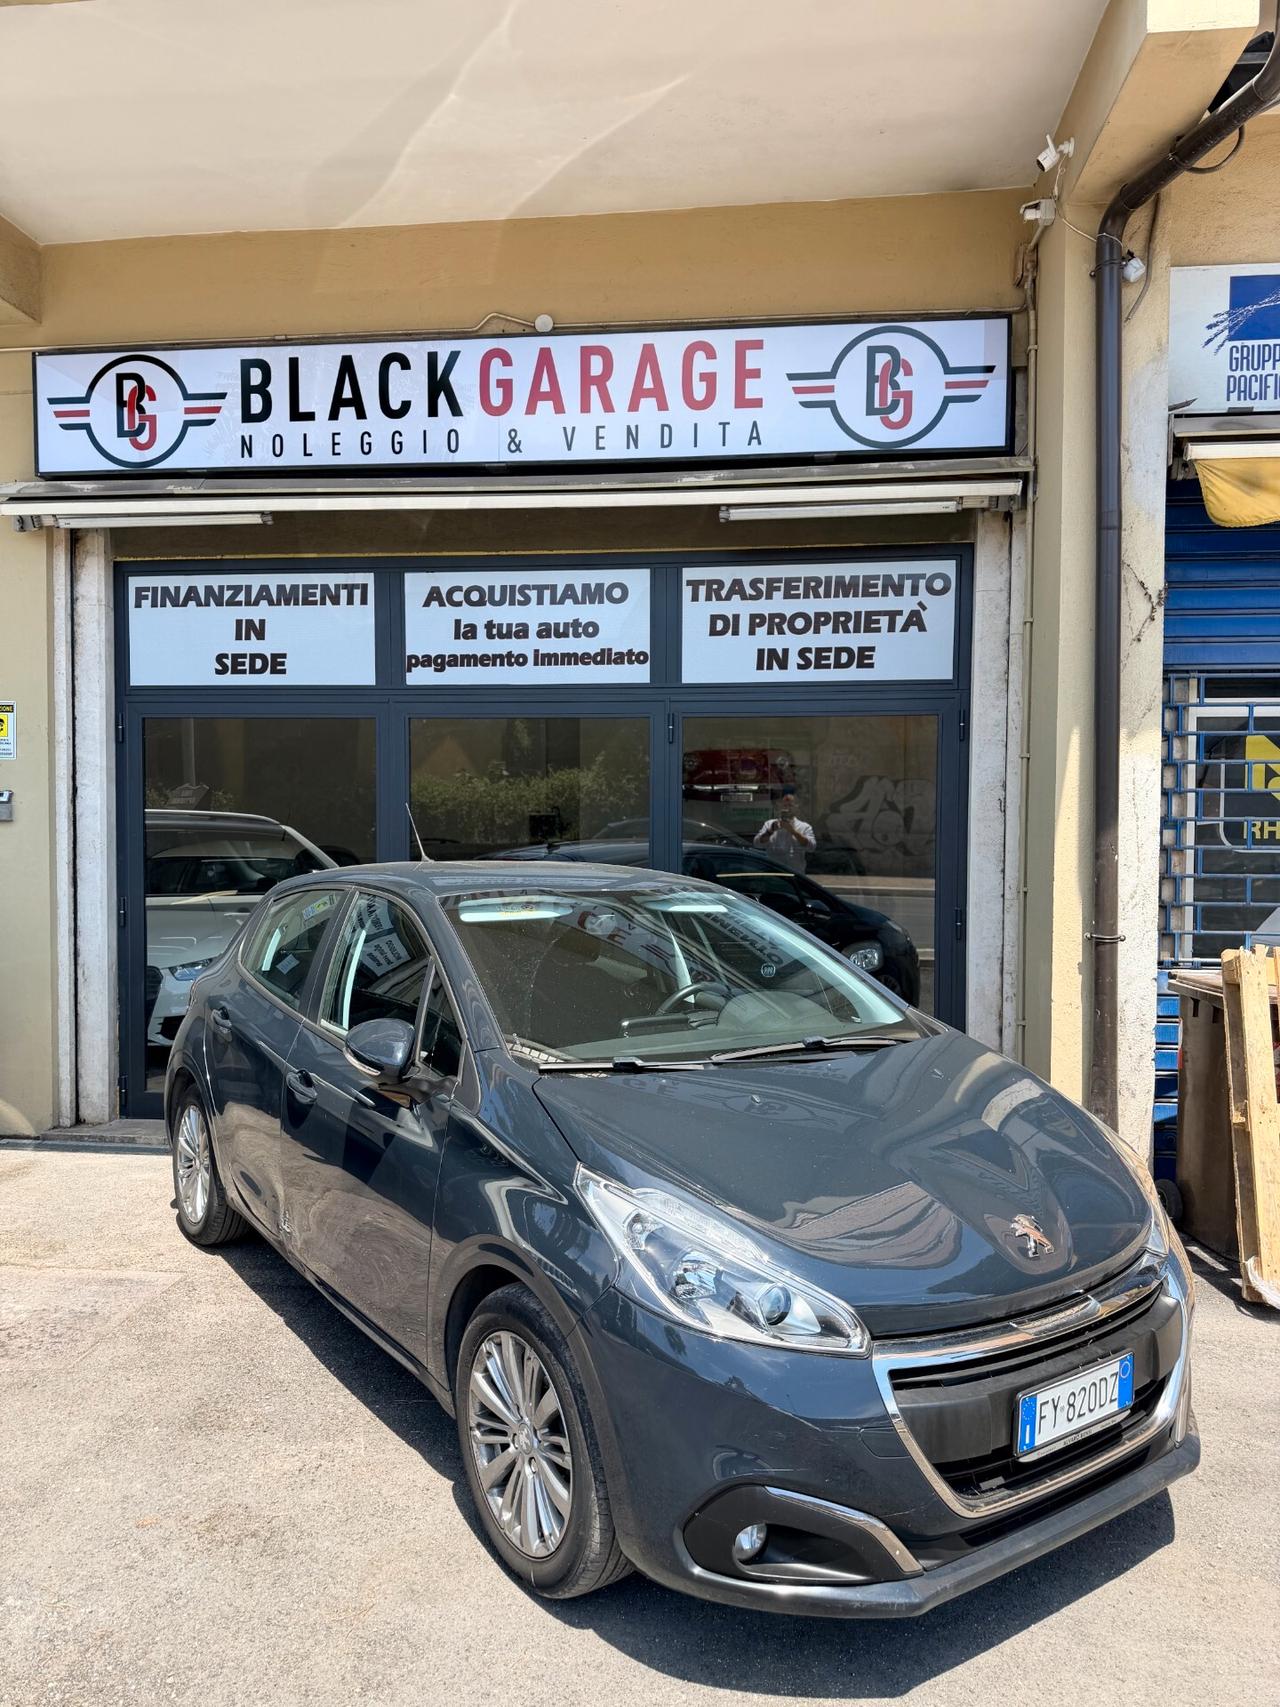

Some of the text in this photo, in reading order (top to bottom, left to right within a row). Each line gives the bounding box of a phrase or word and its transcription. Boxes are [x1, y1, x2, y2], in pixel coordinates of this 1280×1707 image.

[1227, 374, 1280, 402] PACIFI
[241, 421, 763, 458] NOLEGGIO & VENDITA
[134, 583, 368, 608] FINANZIAMENTI
[422, 582, 629, 607] ACQUISTIAMO
[686, 572, 951, 602] TRASFERIMENTO
[235, 619, 265, 640] IN
[454, 618, 599, 640] la tua auto
[709, 601, 927, 636] DI PROPRIETÀ
[215, 653, 287, 675] SEDE
[406, 648, 649, 673] pagamento immediato
[756, 646, 876, 670] IN SEDE
